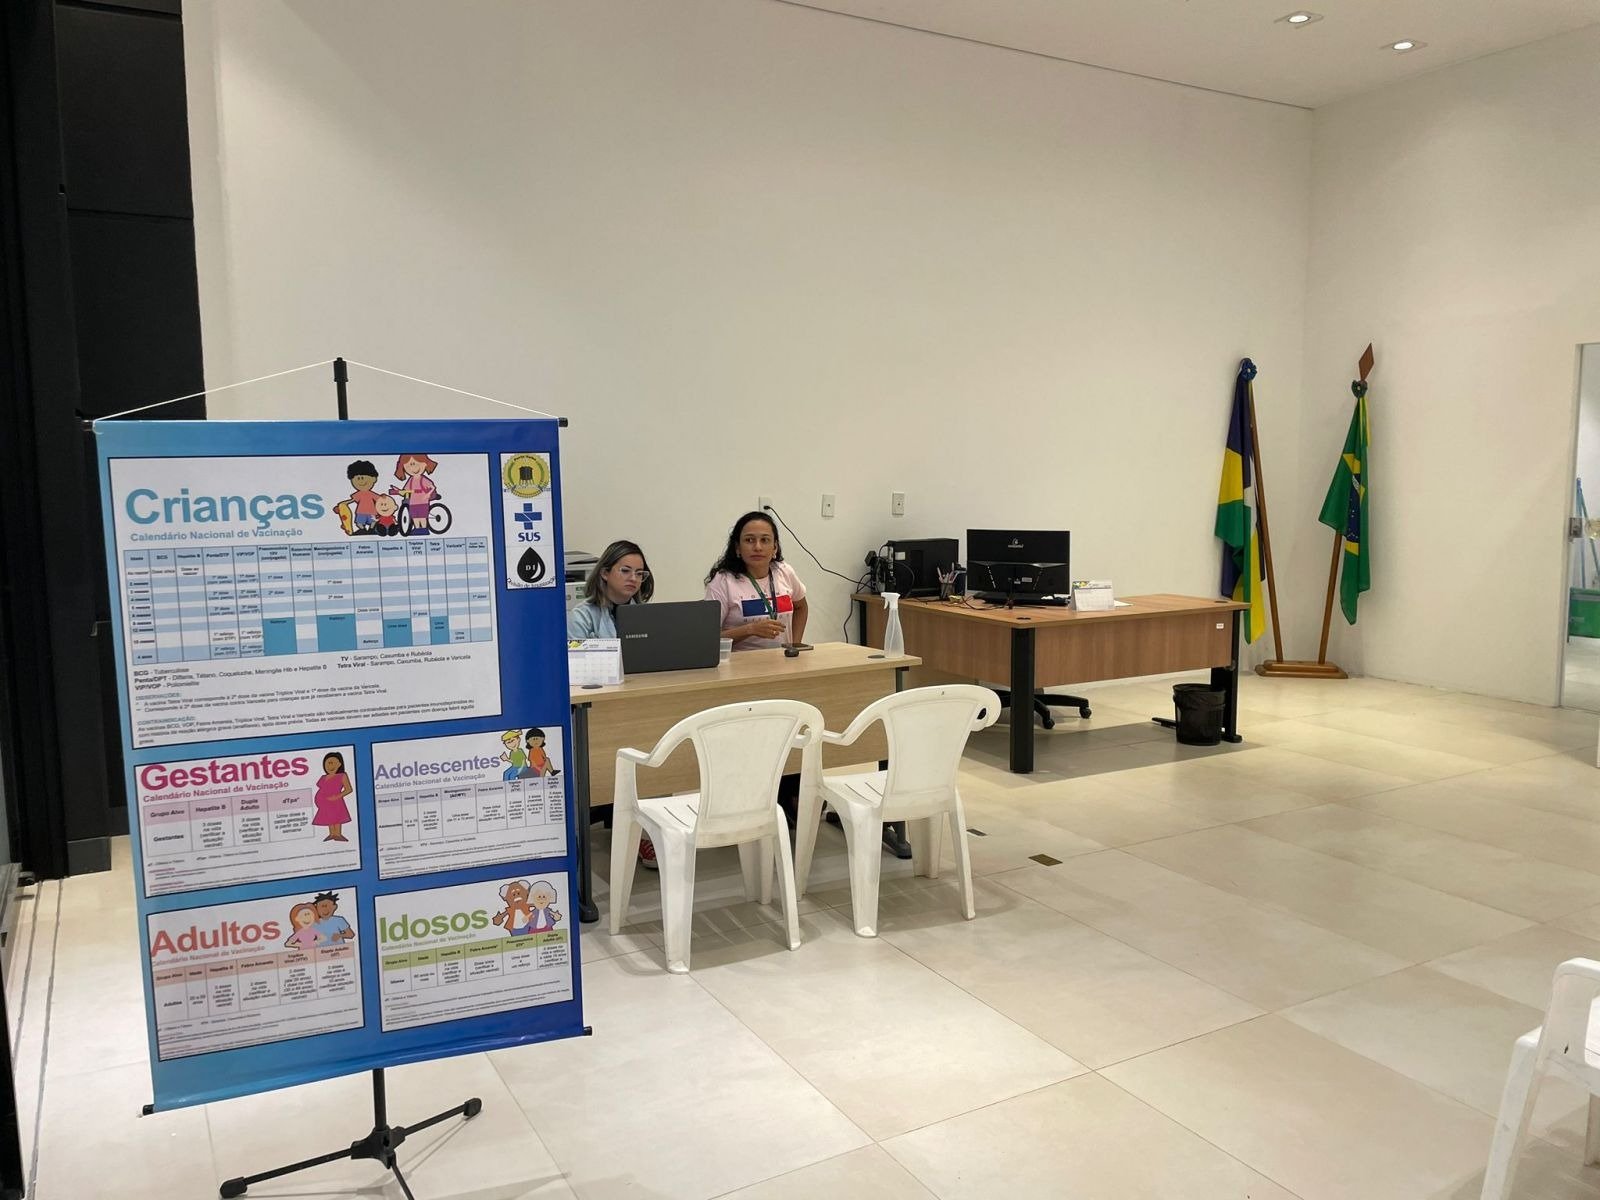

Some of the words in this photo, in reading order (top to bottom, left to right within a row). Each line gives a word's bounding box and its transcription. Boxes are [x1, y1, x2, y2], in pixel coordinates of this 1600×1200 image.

[126, 488, 325, 529] Crianças
[131, 530, 187, 541] Calendário
[190, 530, 234, 539] Nacional
[237, 530, 249, 538] de
[251, 528, 303, 538] Vacinação
[518, 532, 542, 542] SUS
[141, 755, 309, 790] Gestantes
[374, 755, 501, 780] Adolescentes
[143, 790, 191, 803] Calendário
[193, 785, 230, 797] Nacional
[233, 784, 243, 792] de
[246, 778, 289, 791] Vacinação
[376, 780, 411, 790] Calendário
[412, 777, 441, 786] Nacional
[452, 773, 485, 782] Vacinação
[153, 833, 184, 842] Gestantes
[380, 909, 489, 943] Idosos
[152, 920, 281, 958] Adultos
